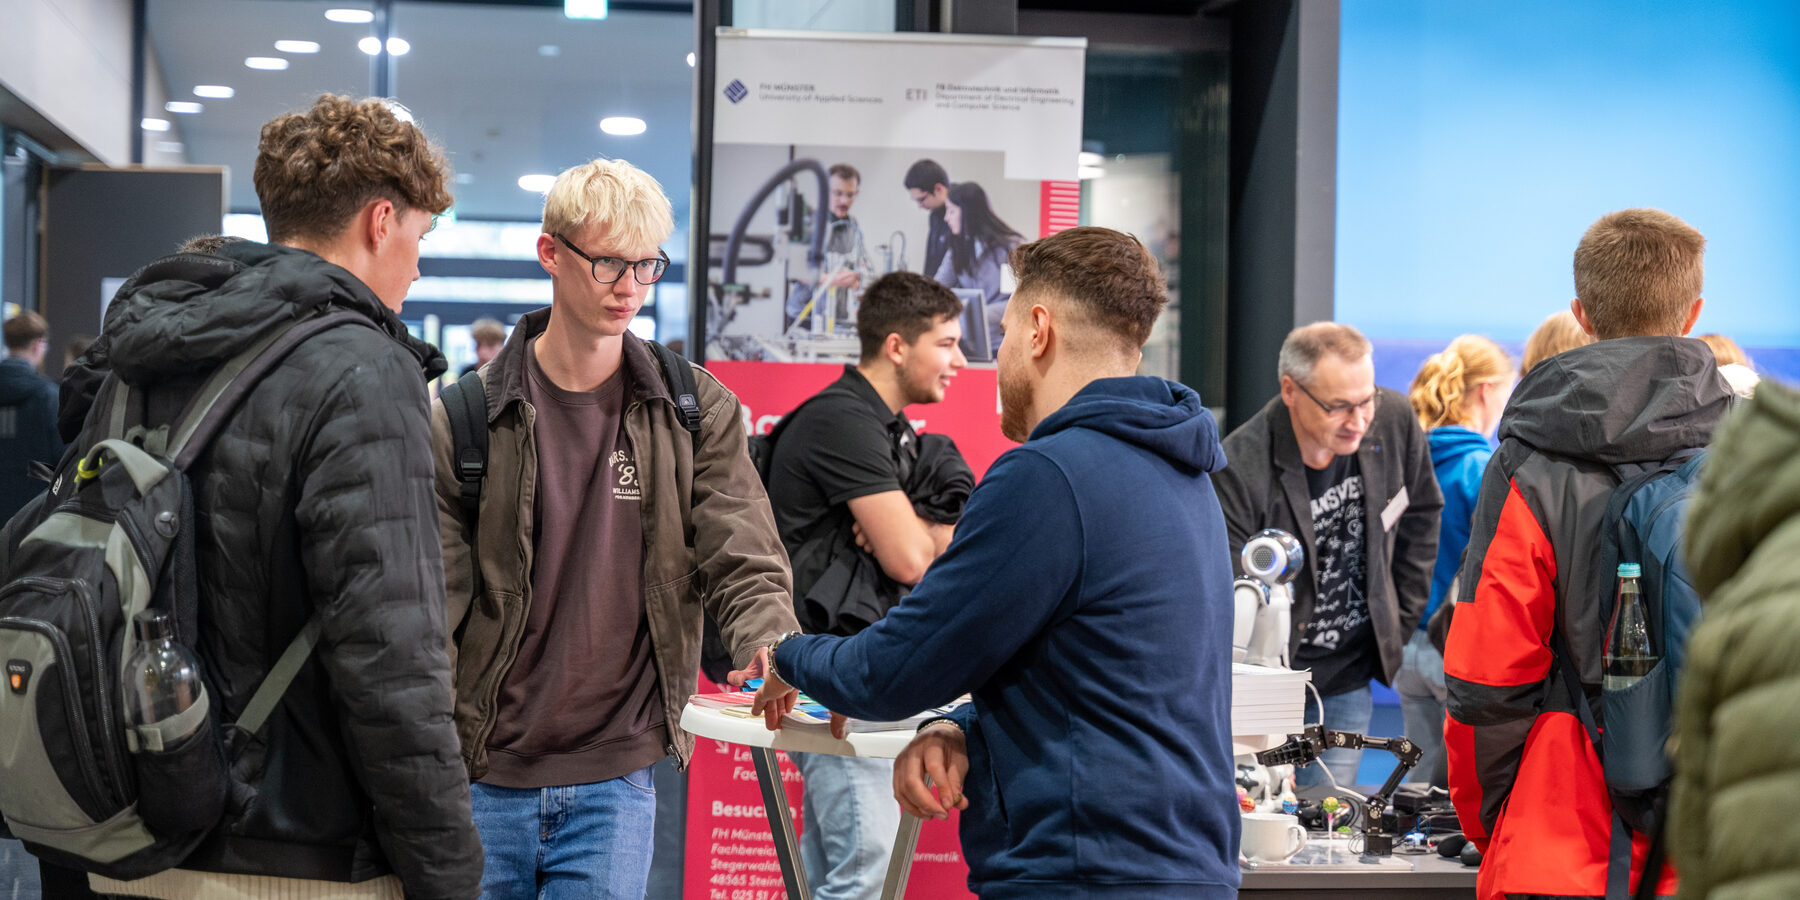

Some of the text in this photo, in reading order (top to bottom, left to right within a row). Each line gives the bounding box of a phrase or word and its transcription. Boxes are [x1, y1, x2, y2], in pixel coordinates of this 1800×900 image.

[905, 88, 928, 101] ETI
[711, 827, 775, 842] FH Münste
[748, 874, 786, 887] Steinf
